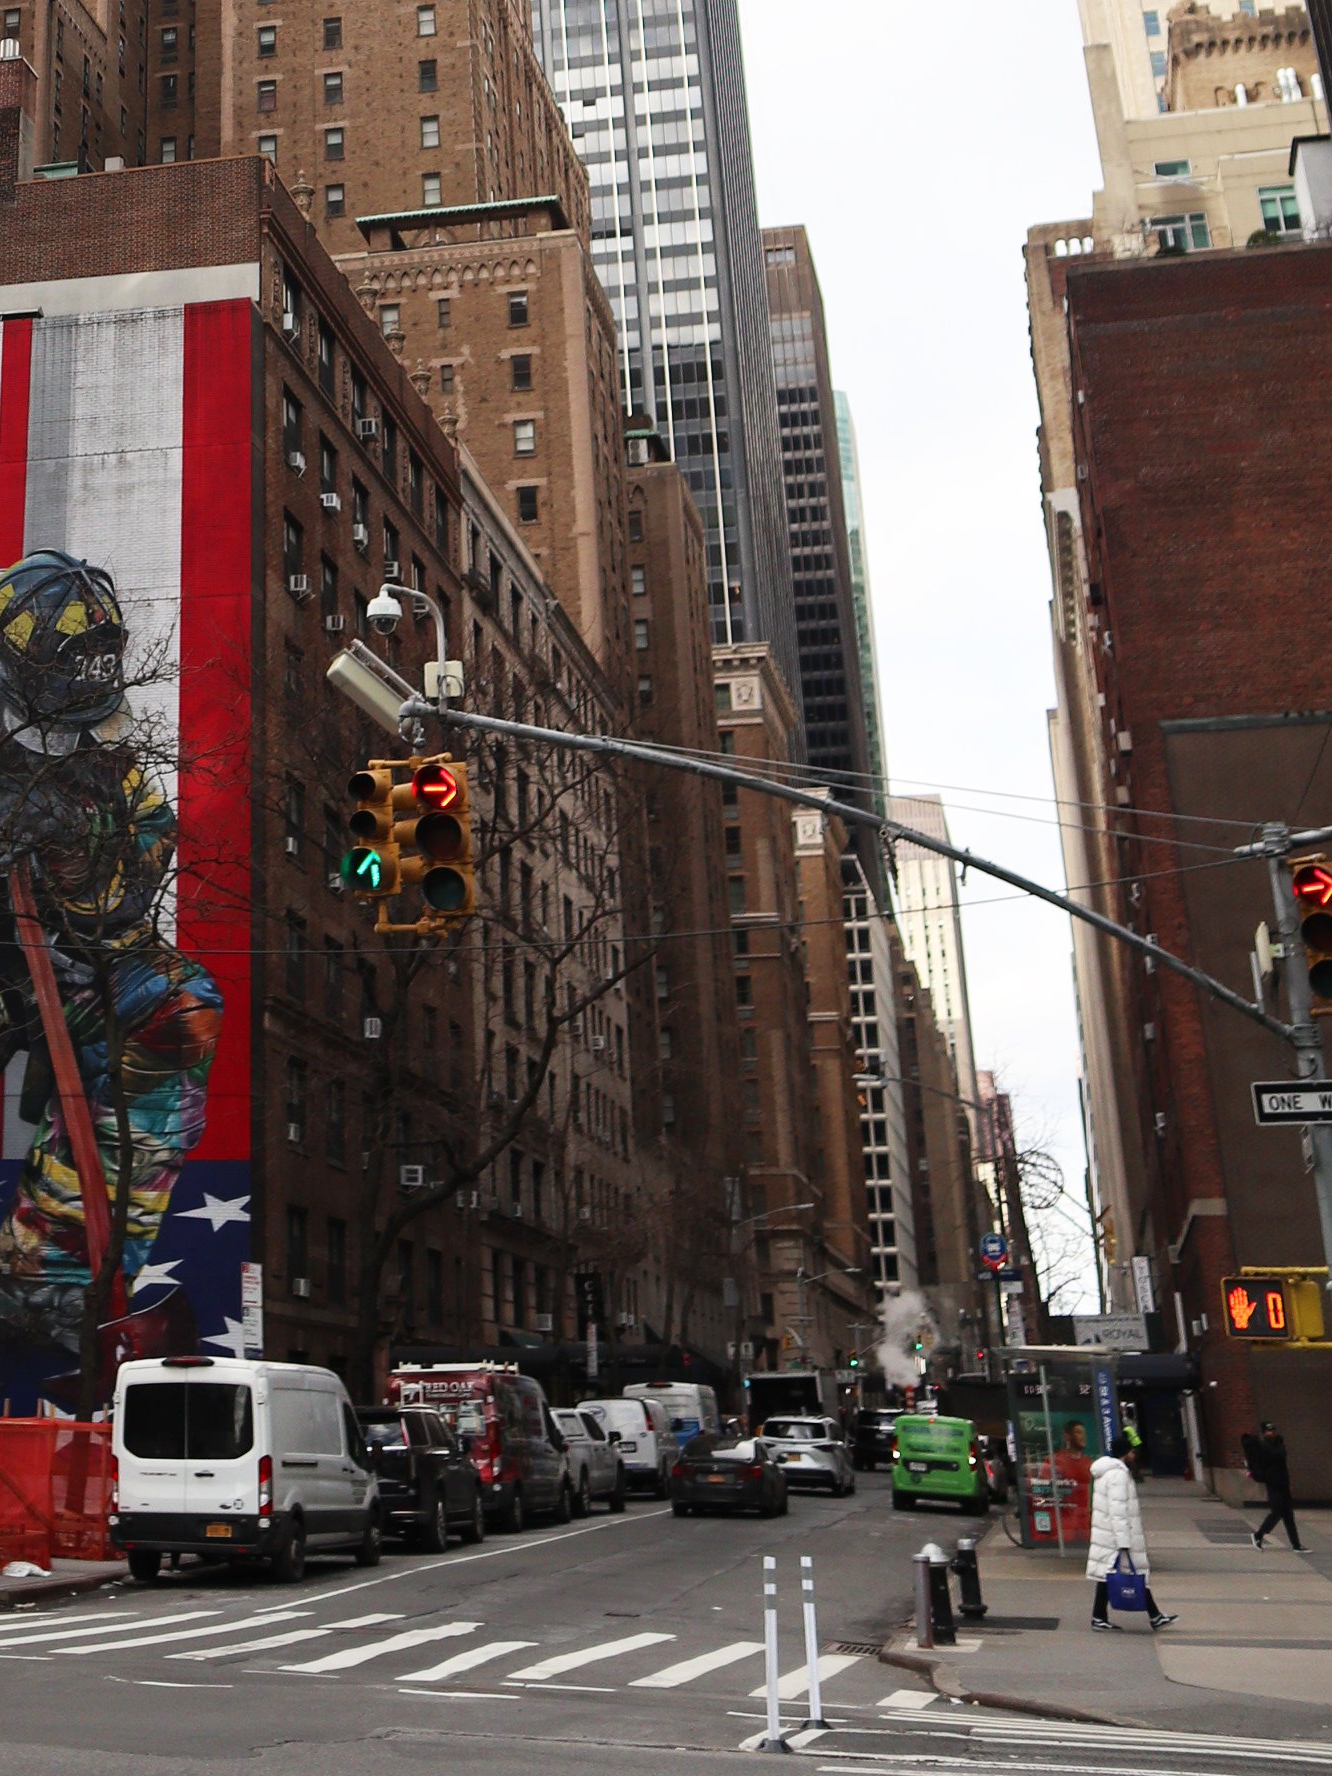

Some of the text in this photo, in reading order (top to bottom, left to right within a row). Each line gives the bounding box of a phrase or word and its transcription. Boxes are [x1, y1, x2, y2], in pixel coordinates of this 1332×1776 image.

[1269, 1095, 1303, 1110] ONE
[1266, 1292, 1285, 1329] 0
[1102, 1328, 1143, 1340] ROYAL
